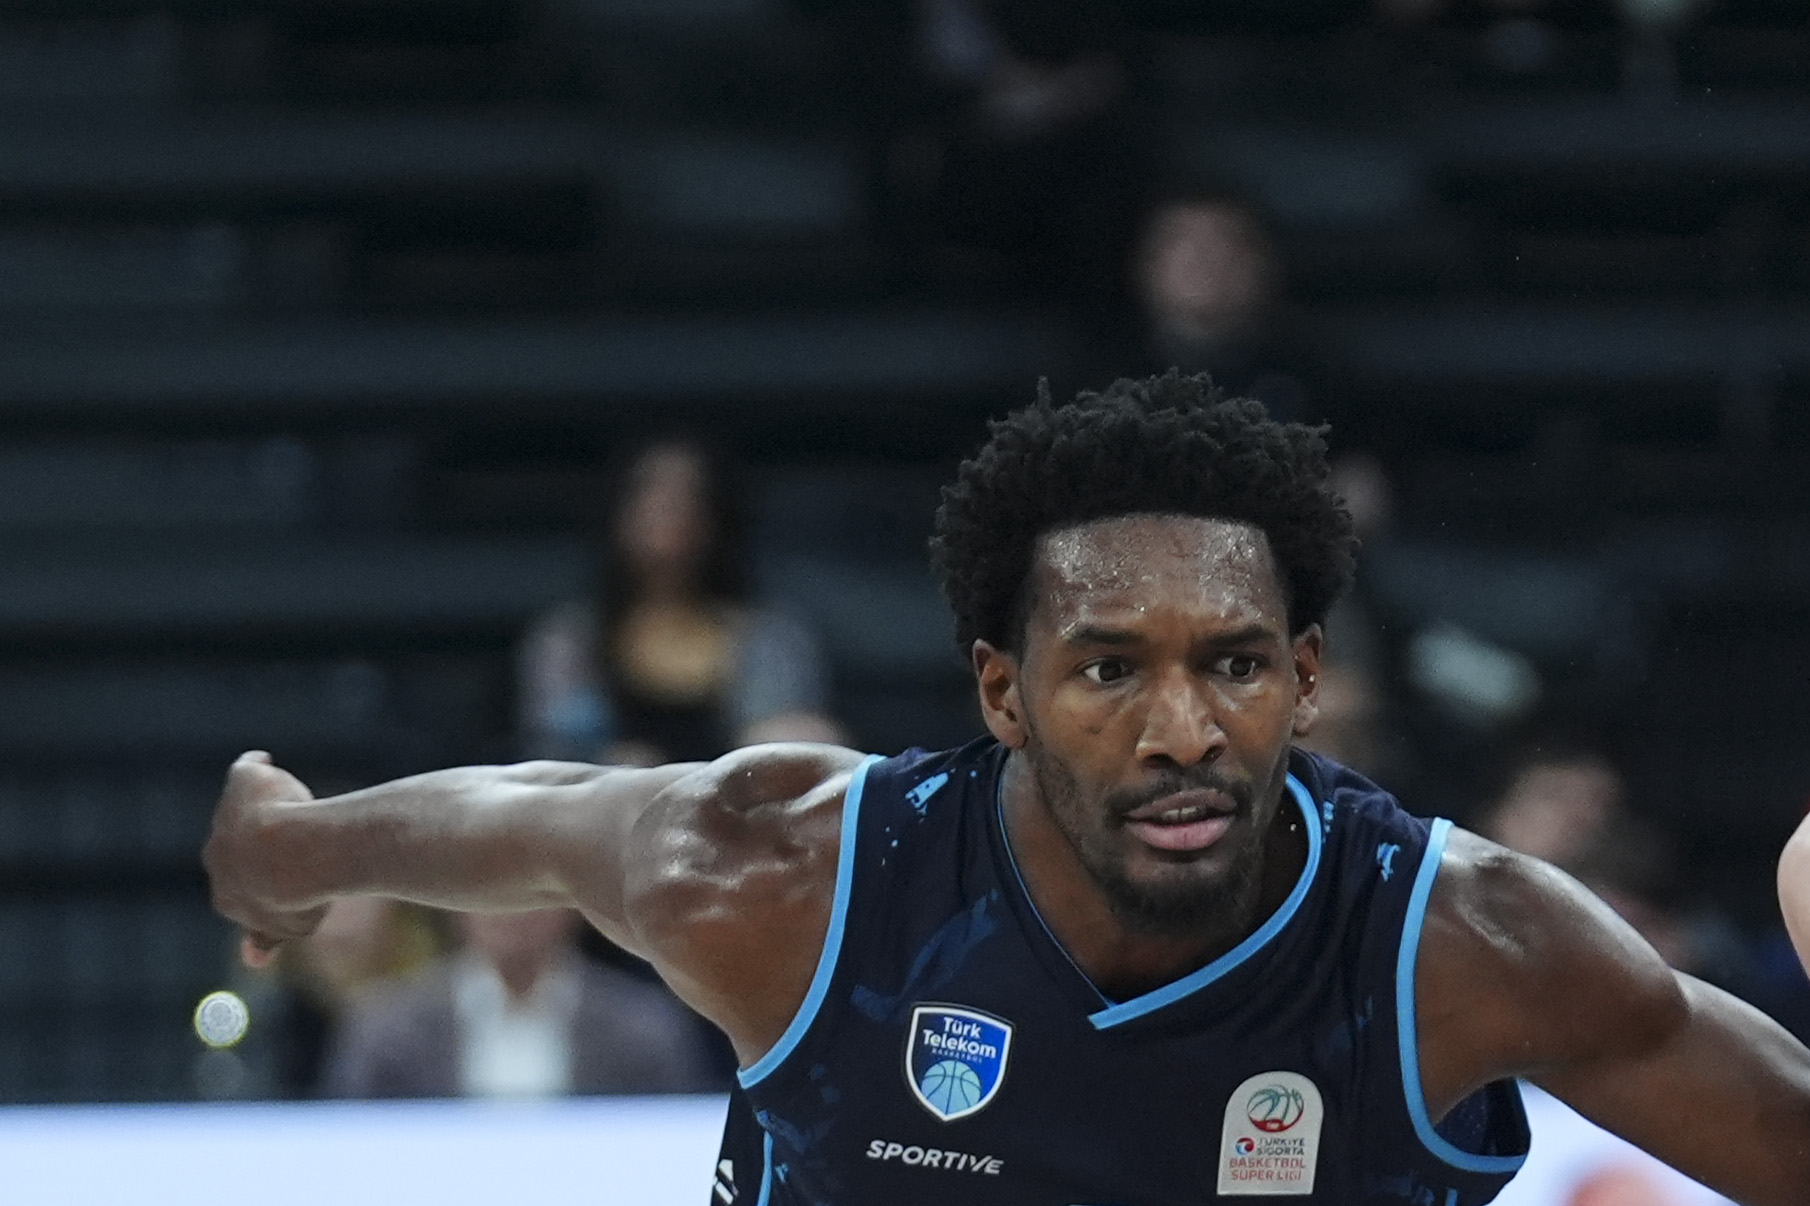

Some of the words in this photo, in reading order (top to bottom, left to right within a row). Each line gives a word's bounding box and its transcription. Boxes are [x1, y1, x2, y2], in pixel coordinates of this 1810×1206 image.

[944, 1017, 981, 1038] Türk
[923, 1029, 997, 1058] Telekom
[866, 1139, 1004, 1174] SPORTIVE
[1229, 1157, 1306, 1169] BASKETBOL
